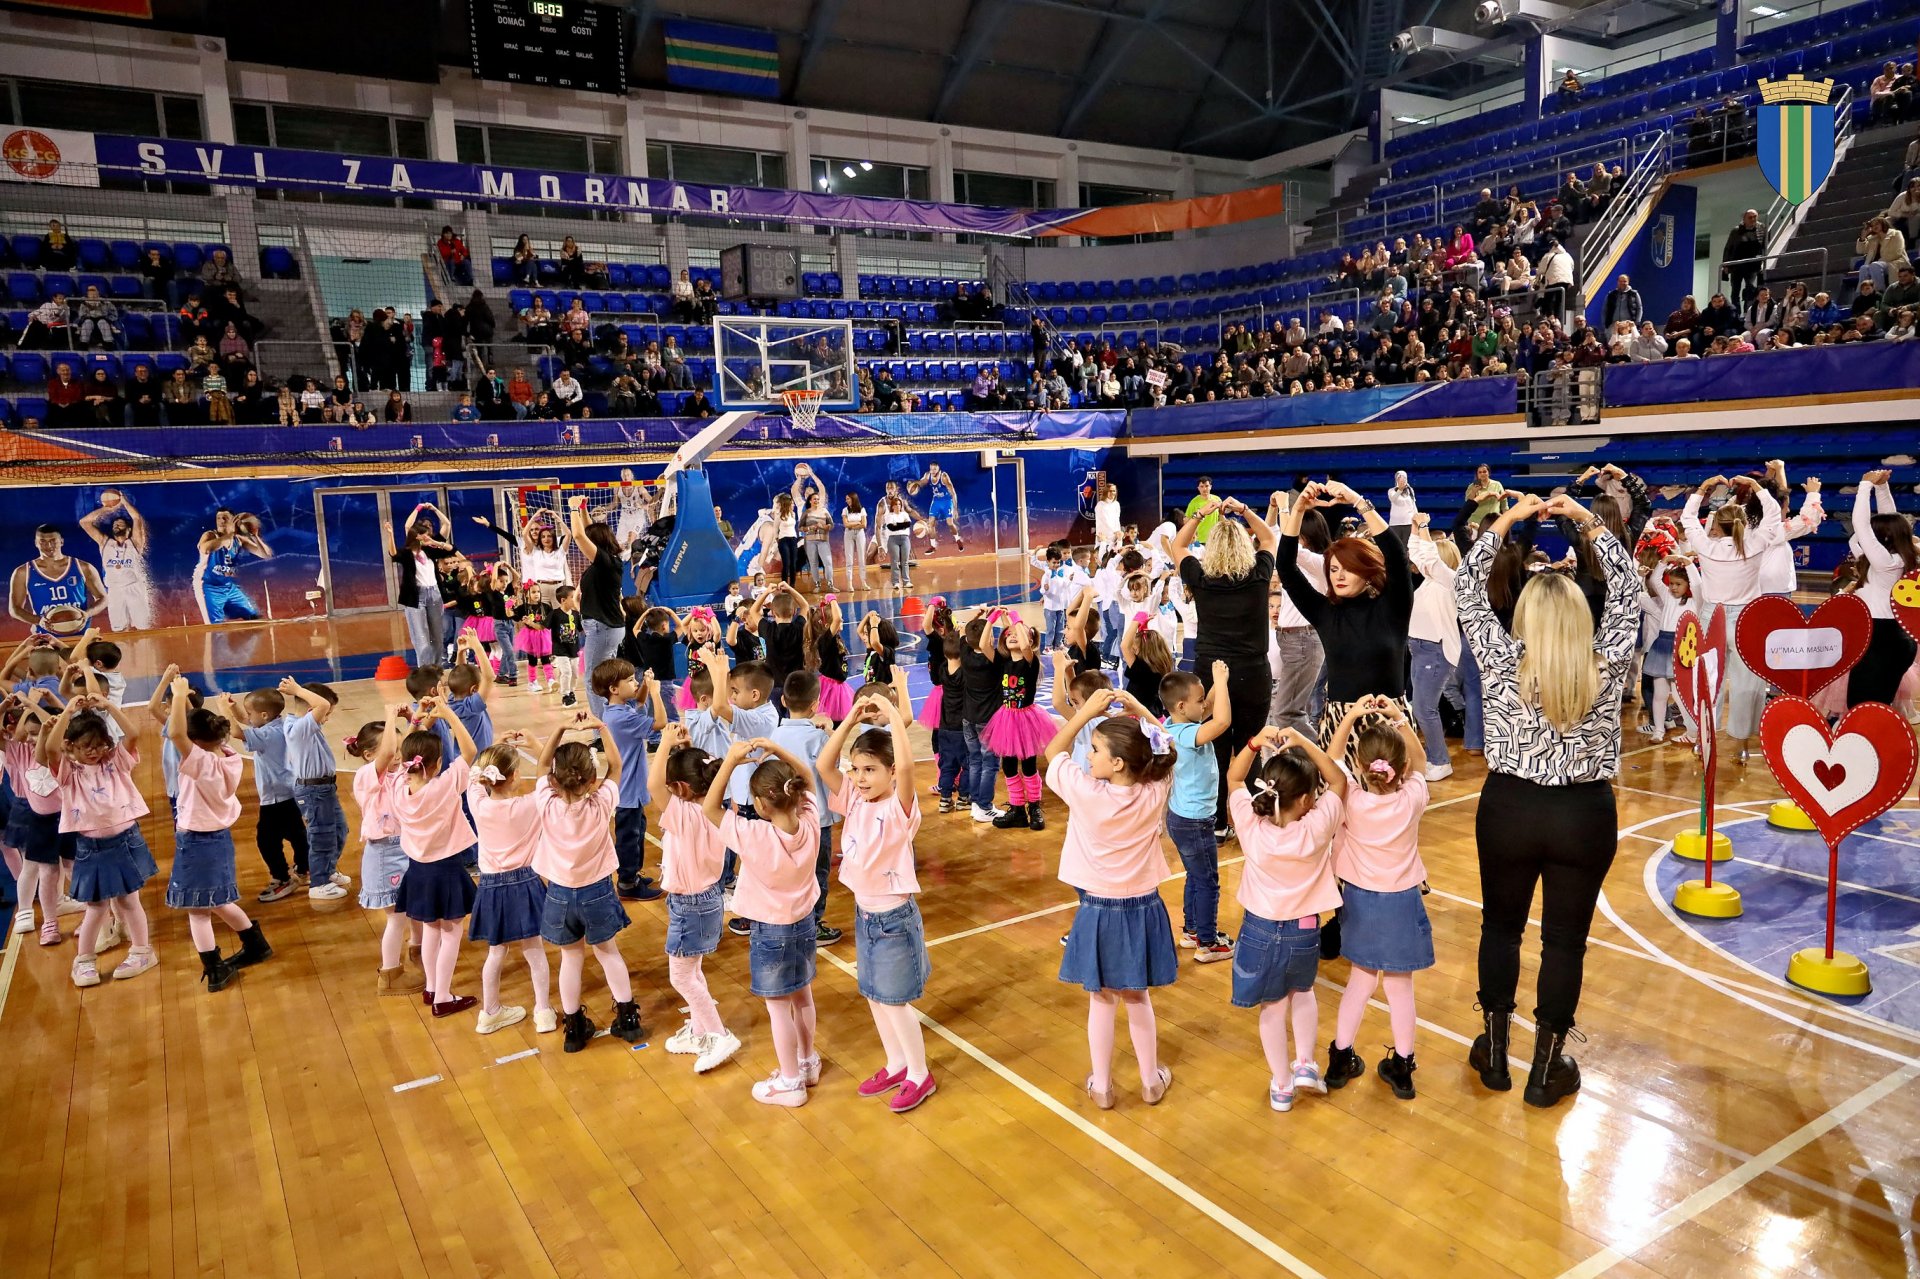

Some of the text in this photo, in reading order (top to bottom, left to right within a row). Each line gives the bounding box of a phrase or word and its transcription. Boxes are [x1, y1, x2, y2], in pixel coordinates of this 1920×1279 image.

[533, 2, 563, 17] 18:03
[571, 26, 592, 36] GOSTI
[138, 143, 729, 213] SVI ZA MORNAR
[671, 541, 689, 574] EASYPLAY
[49, 586, 68, 601] 10
[1002, 673, 1025, 689] 80s
